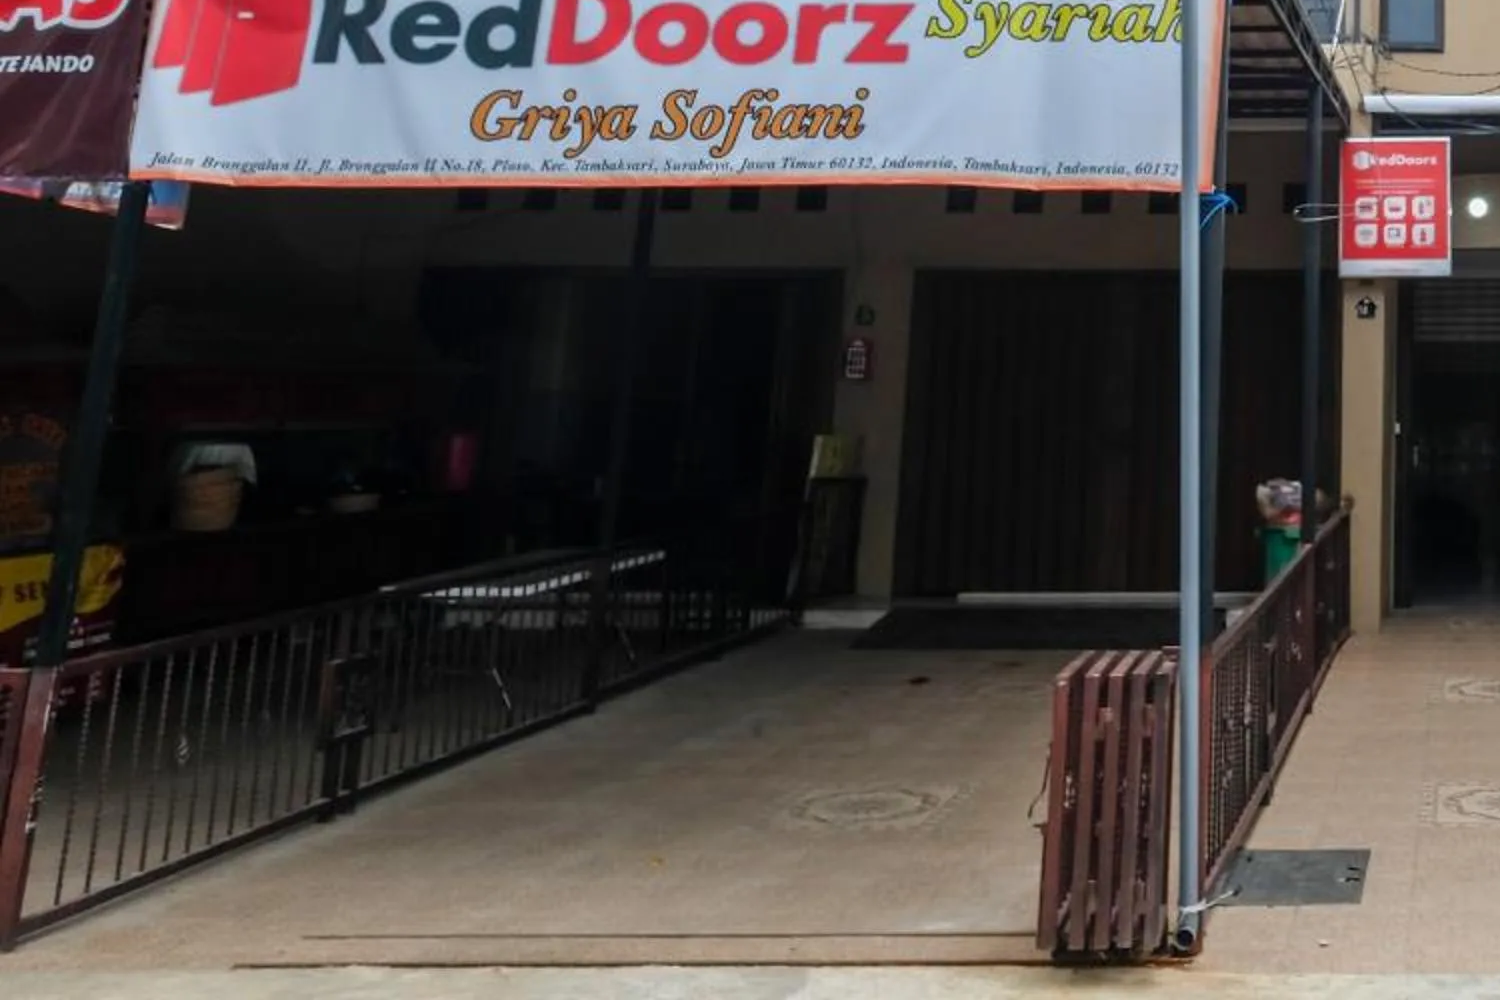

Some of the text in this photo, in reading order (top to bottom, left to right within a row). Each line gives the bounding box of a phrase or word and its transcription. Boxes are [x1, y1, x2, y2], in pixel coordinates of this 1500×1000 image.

[470, 87, 871, 158] Griya Sofiani
[146, 152, 195, 168] Jalan
[736, 156, 776, 174] Jawa
[781, 156, 824, 170] Timur
[881, 155, 958, 172] Indonesia,
